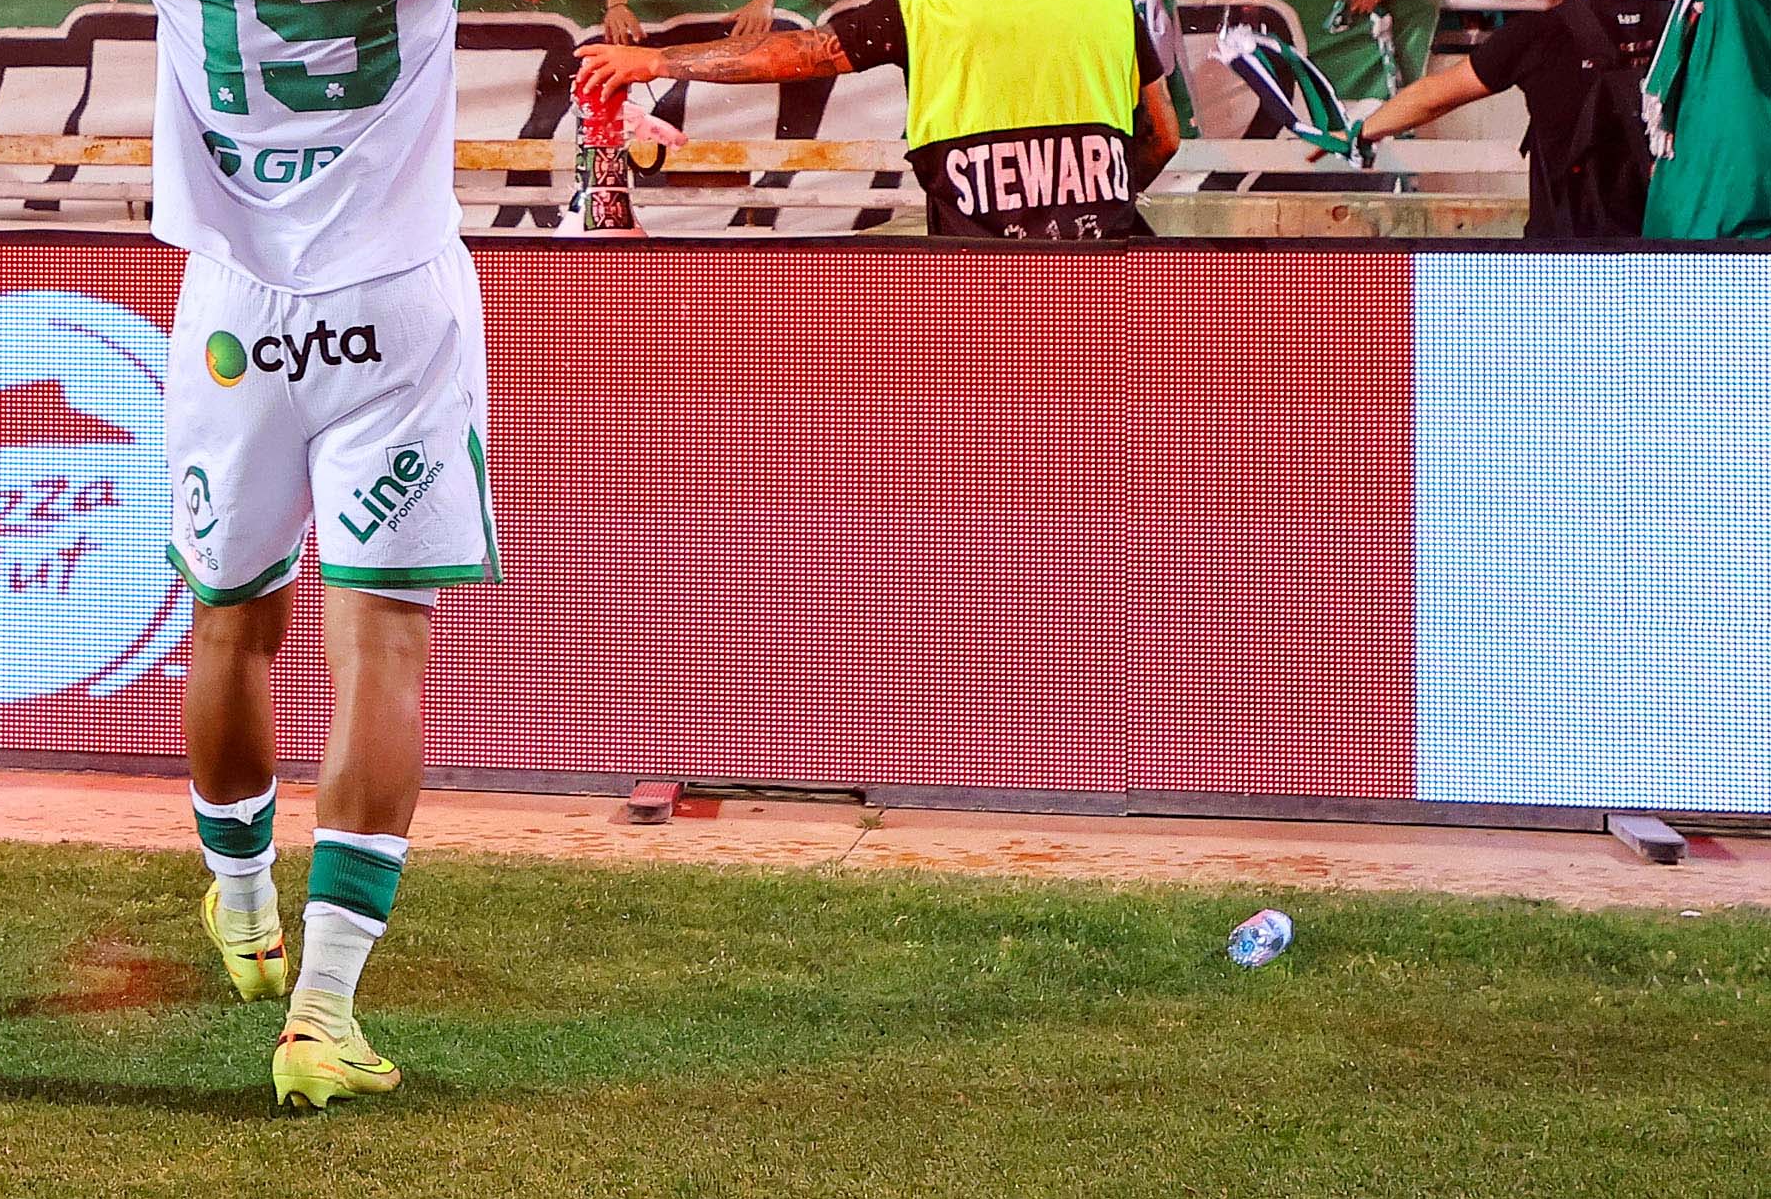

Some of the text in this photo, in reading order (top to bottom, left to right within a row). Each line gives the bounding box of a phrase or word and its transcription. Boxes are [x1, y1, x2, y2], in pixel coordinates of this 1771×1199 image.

[946, 134, 1130, 216] STEWARD
[251, 319, 383, 383] cyta
[338, 448, 428, 546] Line
[387, 459, 446, 533] promotions
